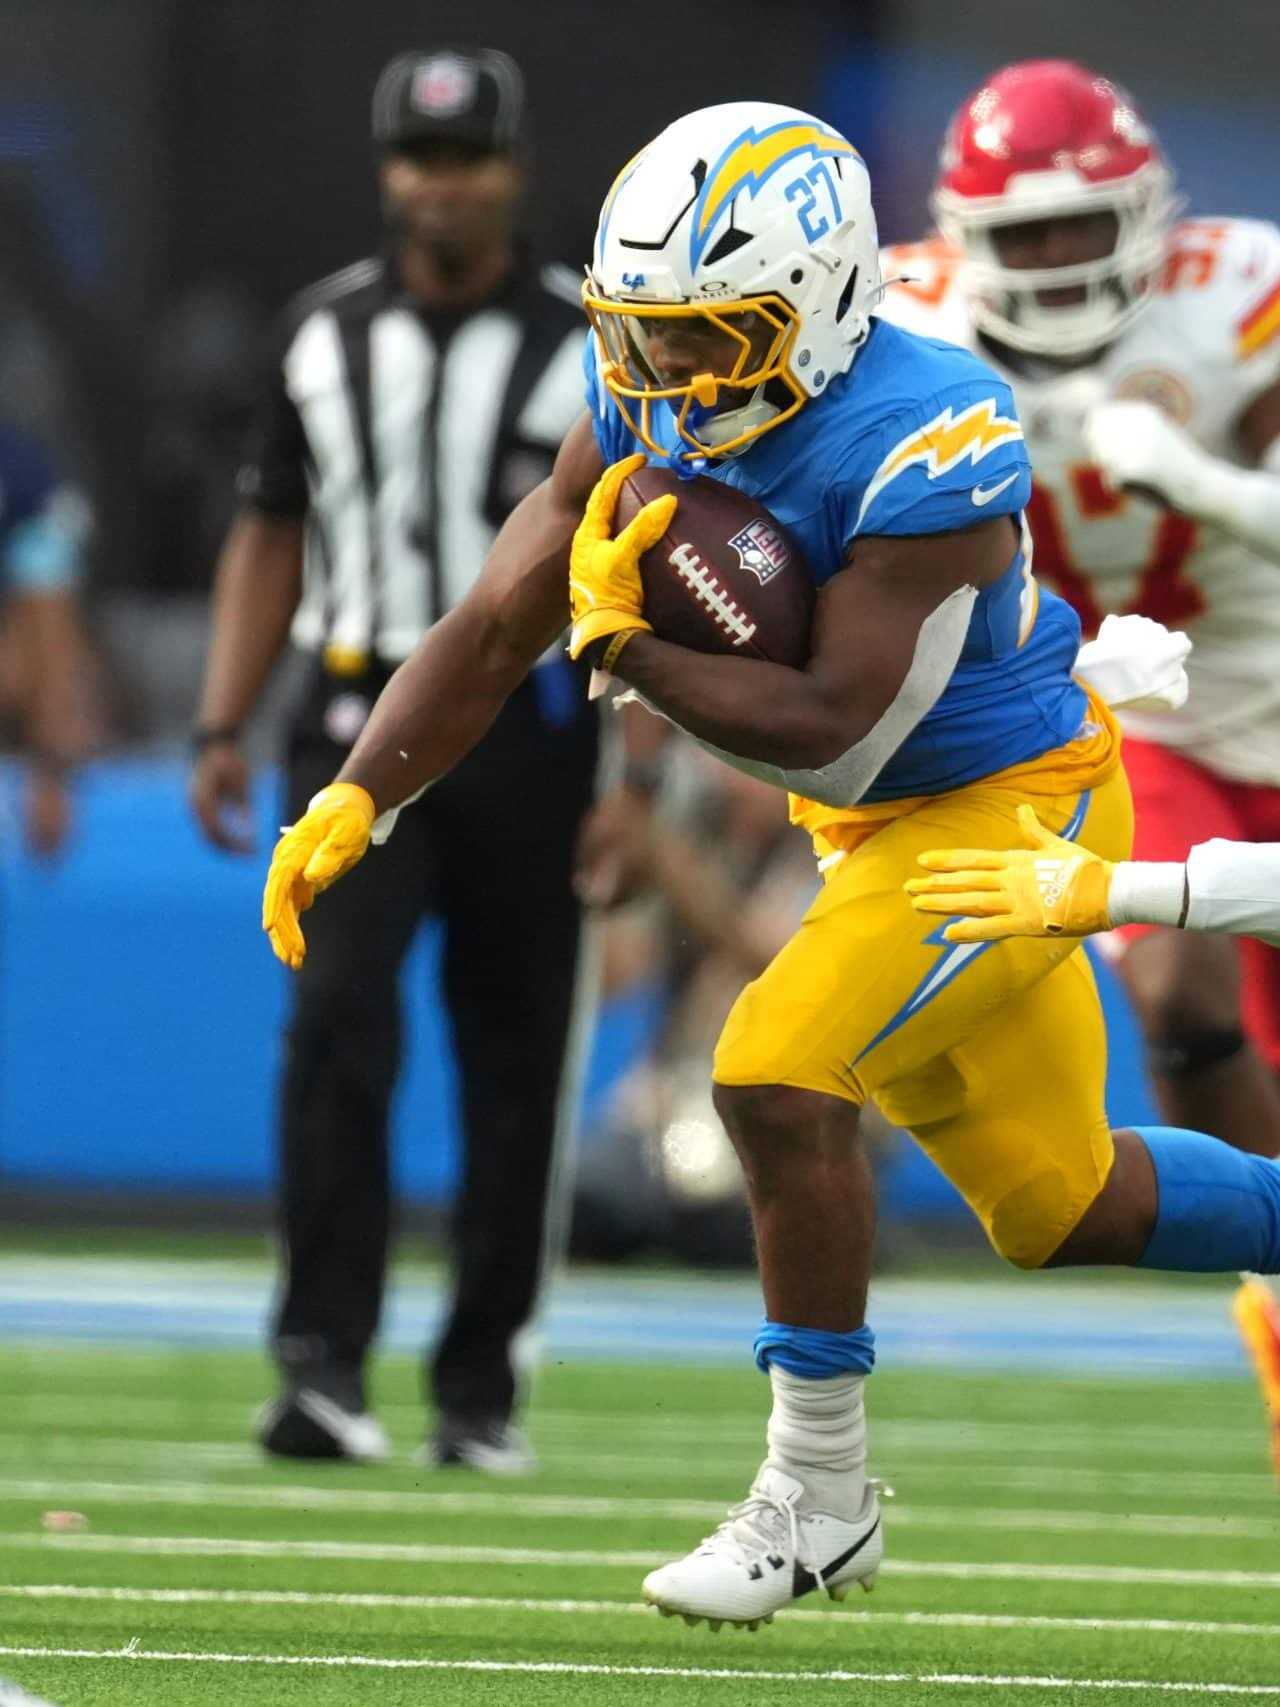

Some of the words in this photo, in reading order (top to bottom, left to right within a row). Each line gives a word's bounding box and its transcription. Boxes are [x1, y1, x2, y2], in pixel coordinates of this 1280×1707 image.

[784, 161, 842, 245] 27
[621, 272, 645, 292] LA
[752, 525, 787, 566] NFL
[1042, 856, 1082, 908] adid
